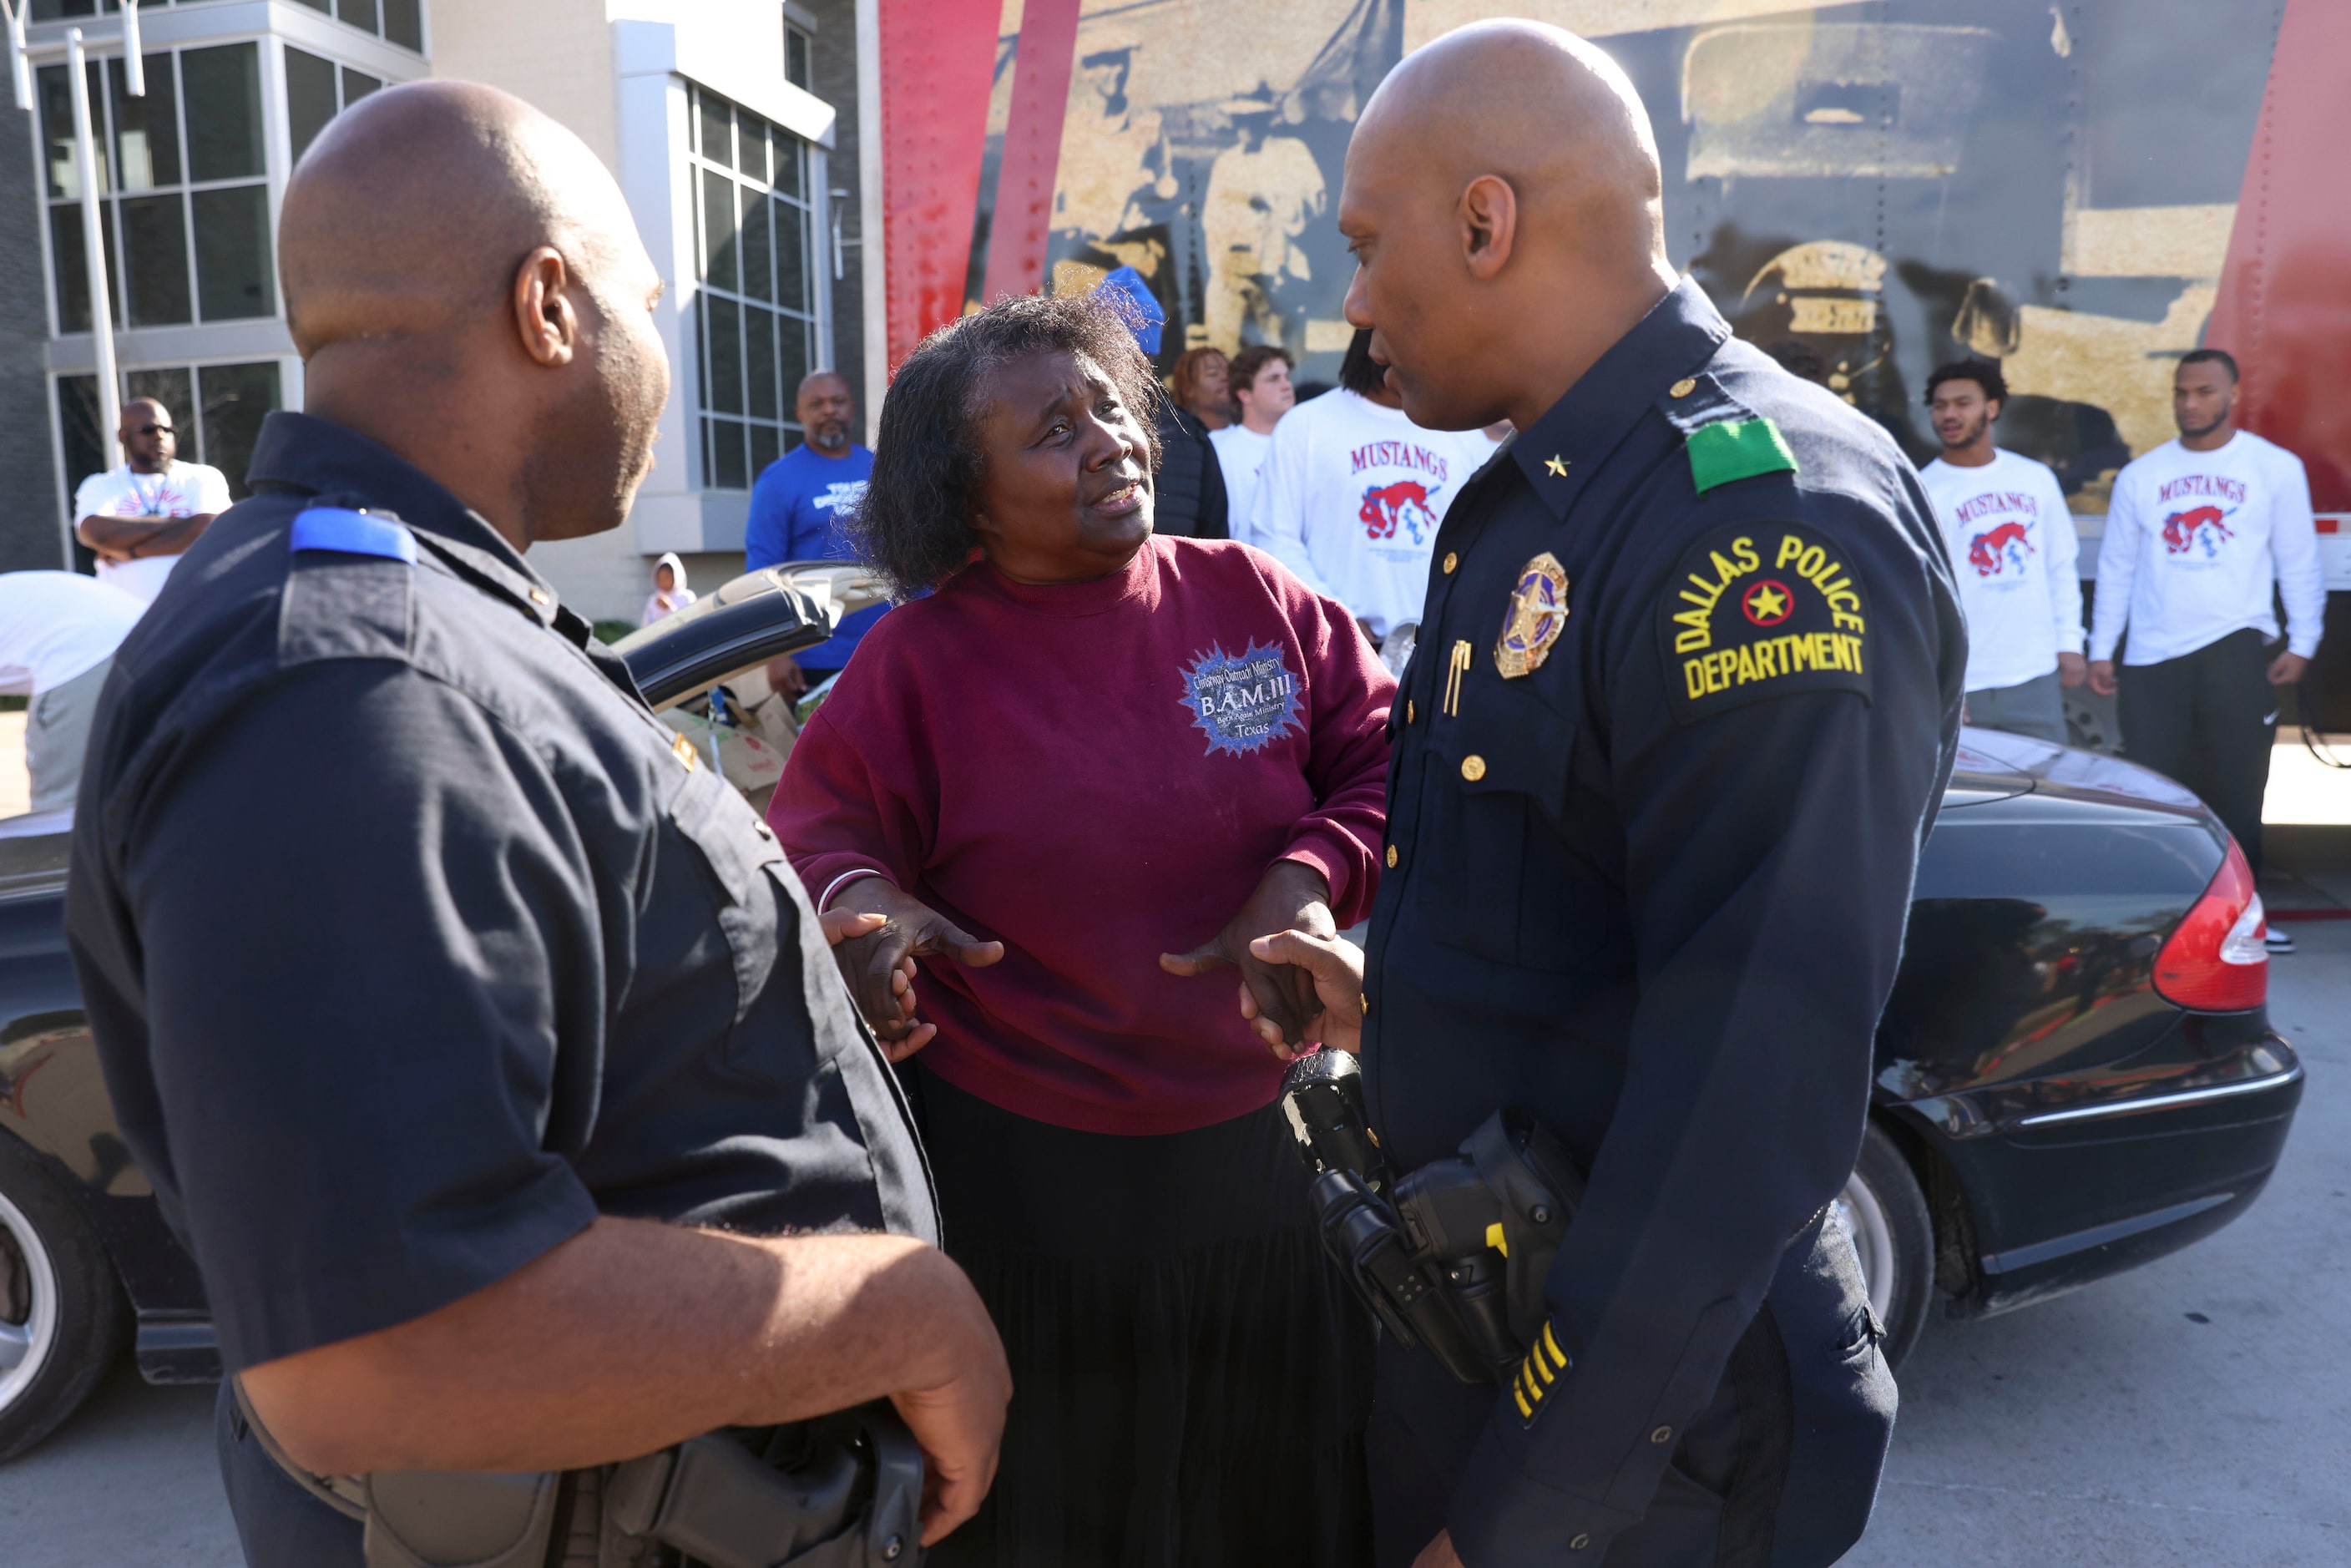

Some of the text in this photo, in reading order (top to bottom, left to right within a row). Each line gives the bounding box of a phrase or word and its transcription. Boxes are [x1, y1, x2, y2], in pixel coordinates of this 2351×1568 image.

[1351, 442, 1447, 482] MUSTANGS
[2157, 475, 2245, 504] MUSTANGS
[1955, 493, 2038, 528] MUSTANGS
[1673, 537, 1760, 654] DALLAS
[1776, 534, 1864, 634] POLICE
[1251, 657, 1282, 675] Ministry
[1683, 632, 1863, 700] DEPARTMENT
[1255, 701, 1285, 716] Ministry
[1235, 723, 1270, 738] Texas
